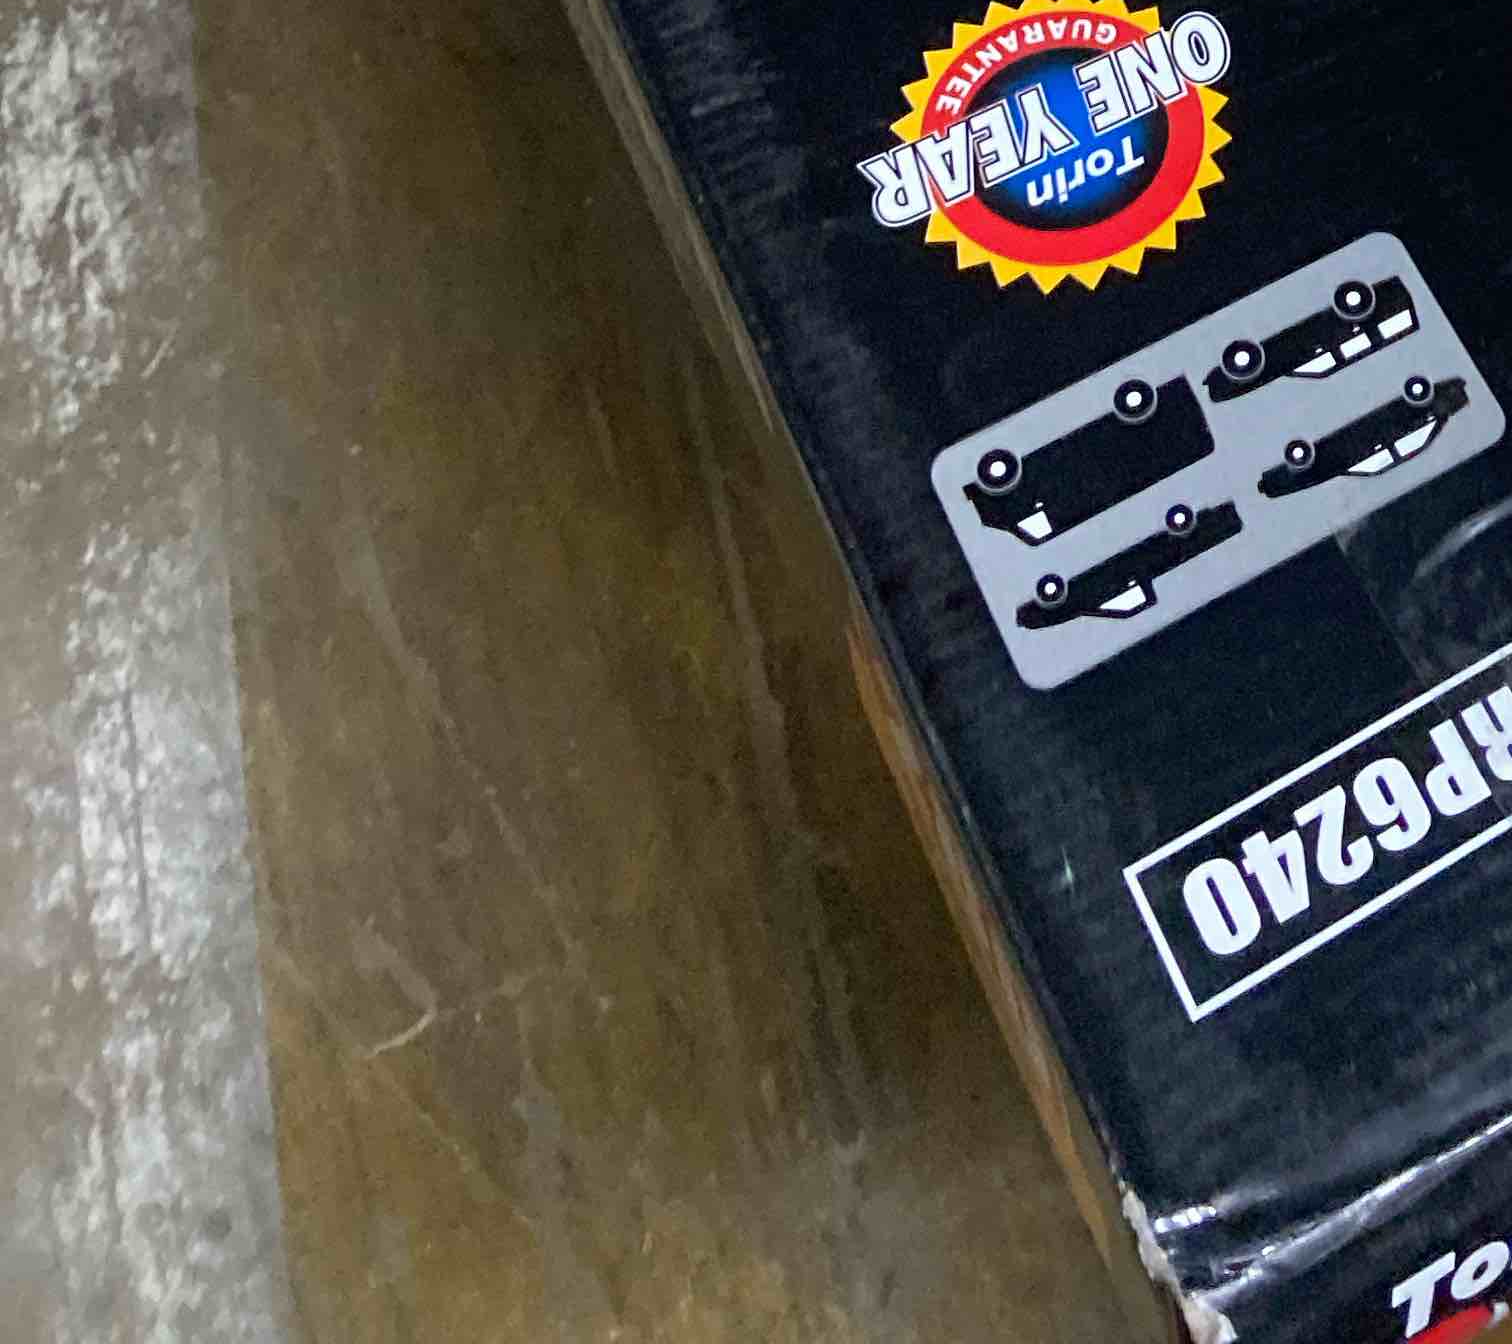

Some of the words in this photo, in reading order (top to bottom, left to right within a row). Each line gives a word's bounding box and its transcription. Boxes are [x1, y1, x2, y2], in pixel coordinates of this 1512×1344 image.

[935, 18, 1118, 115] GUARANTEE
[1073, 11, 1231, 136] ONE
[857, 83, 1079, 228] YEAR
[1026, 134, 1145, 208] Torin
